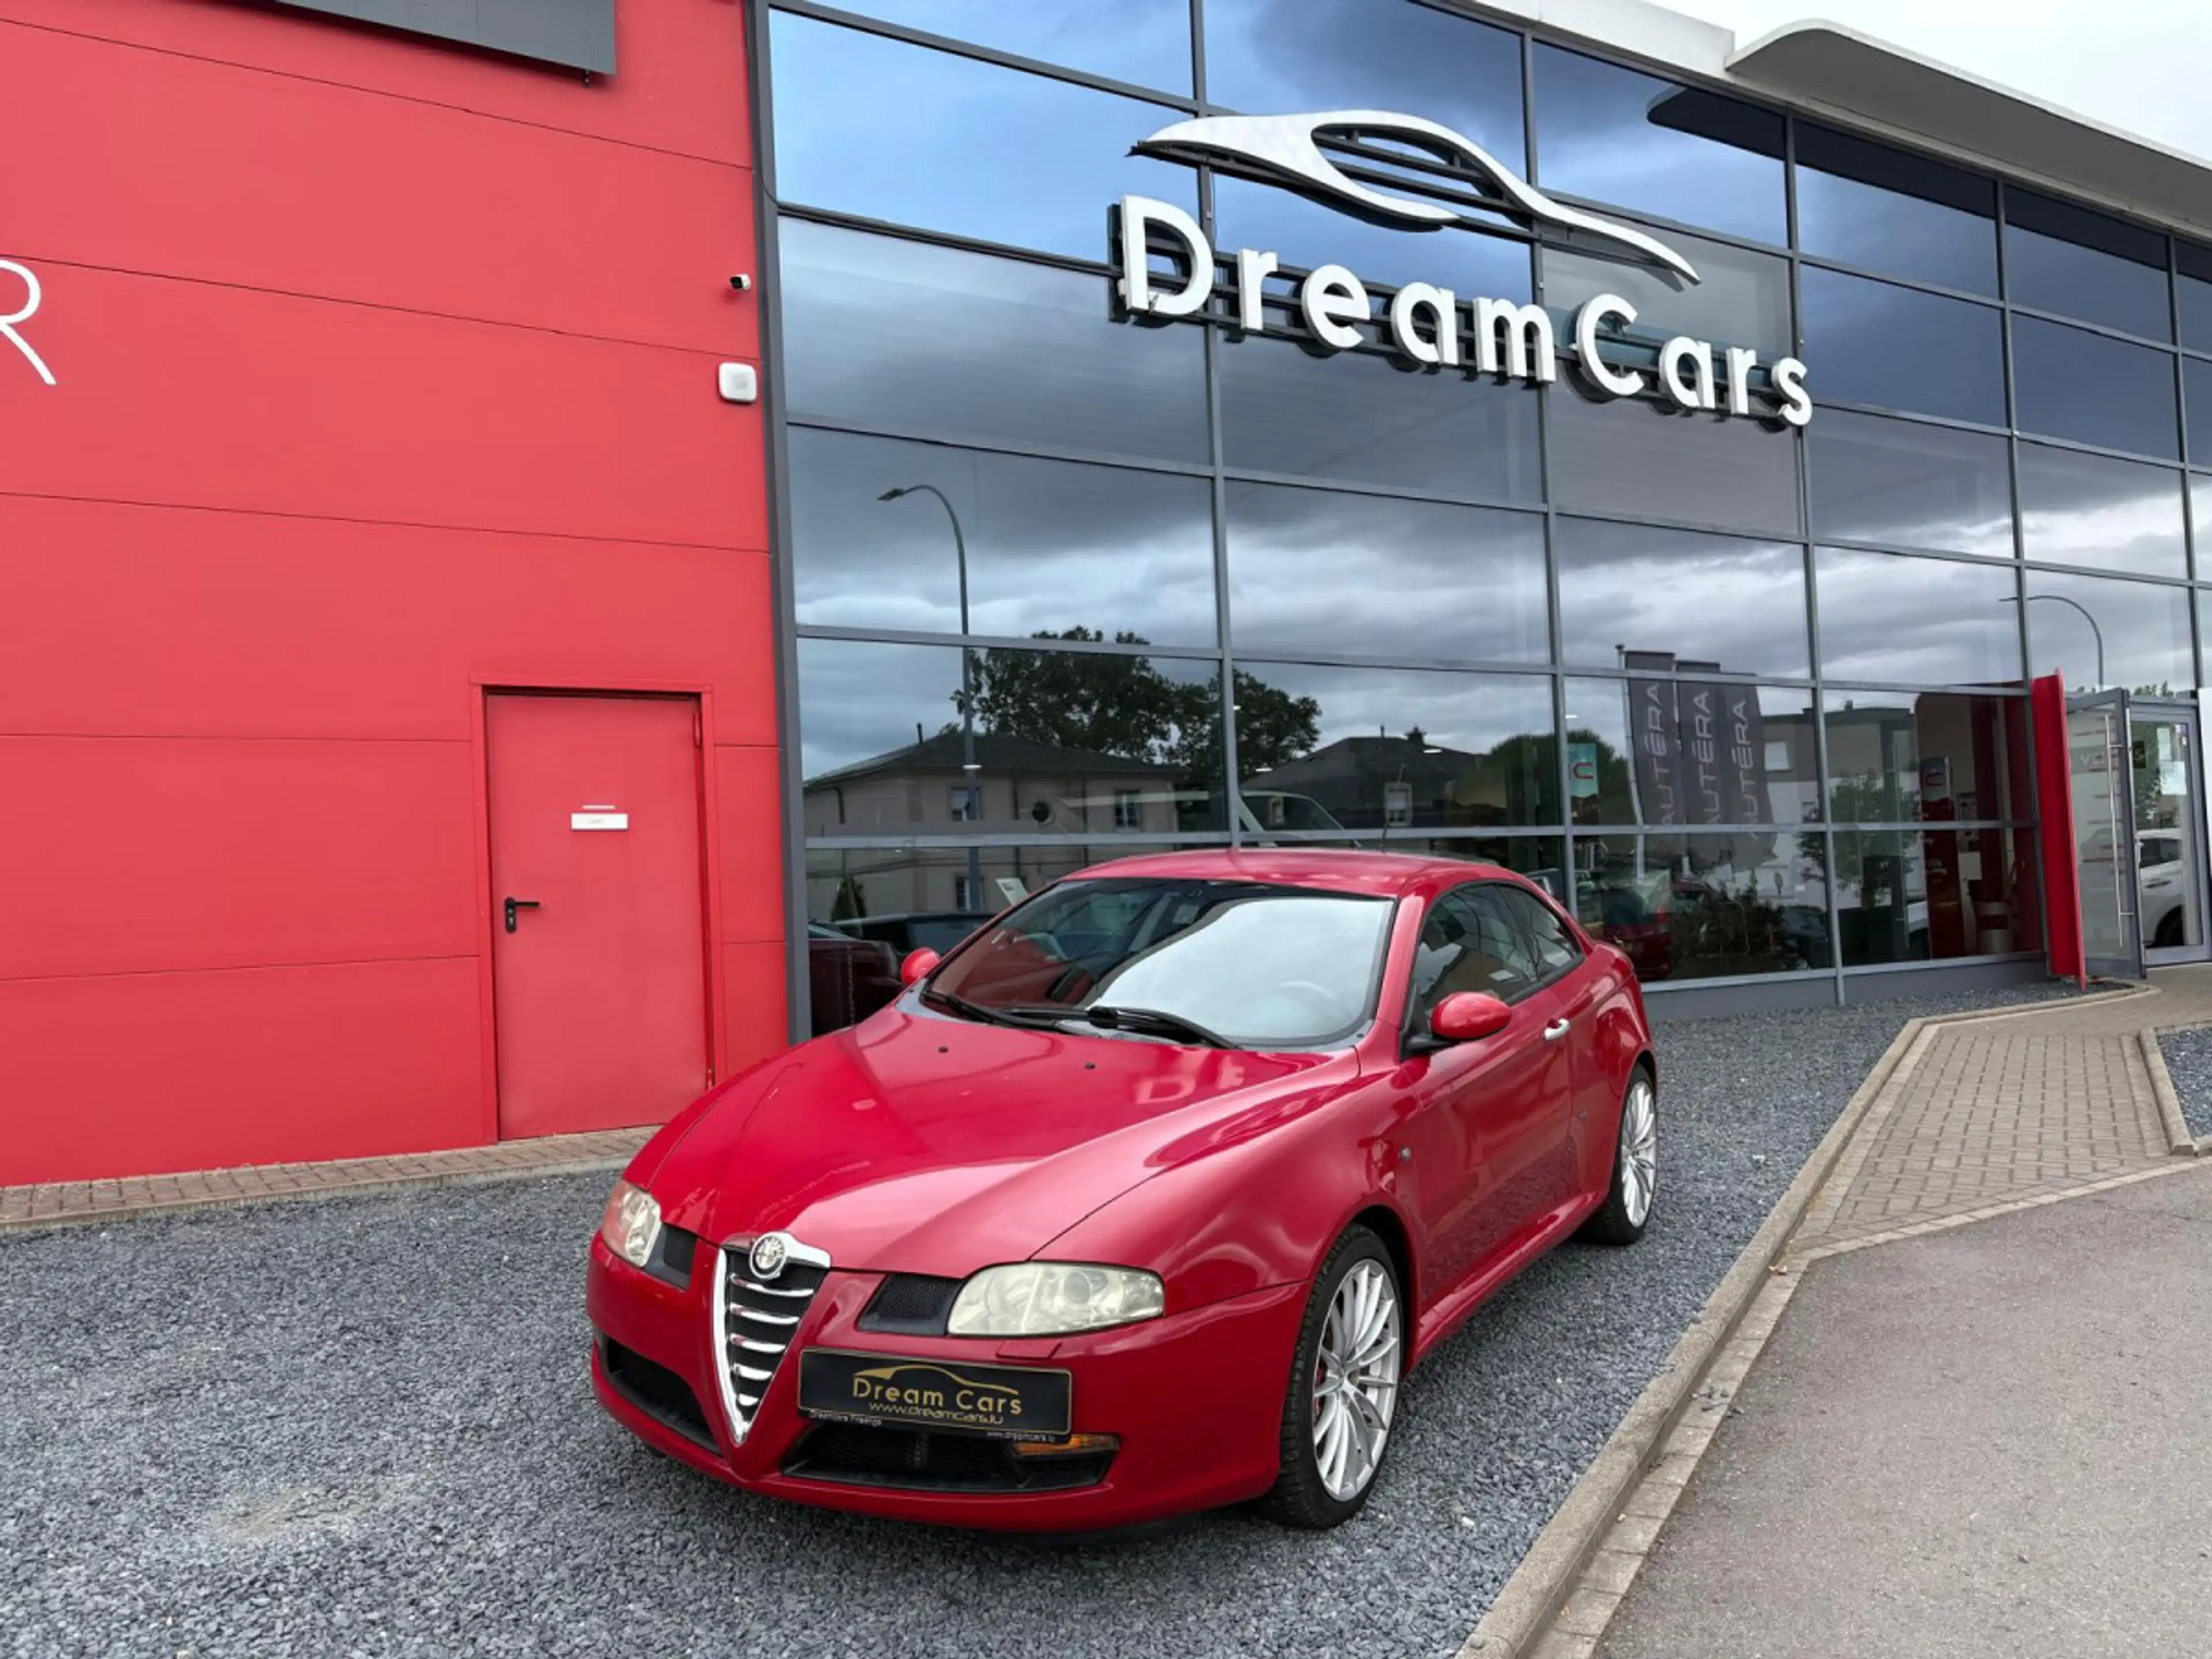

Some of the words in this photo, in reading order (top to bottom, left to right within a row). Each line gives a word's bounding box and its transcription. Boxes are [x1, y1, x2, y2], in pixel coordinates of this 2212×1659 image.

[1119, 194, 1556, 384] Dream
[1571, 292, 1814, 427] Cars
[853, 1377, 944, 1407] Dream
[956, 1389, 1022, 1415] Cars
